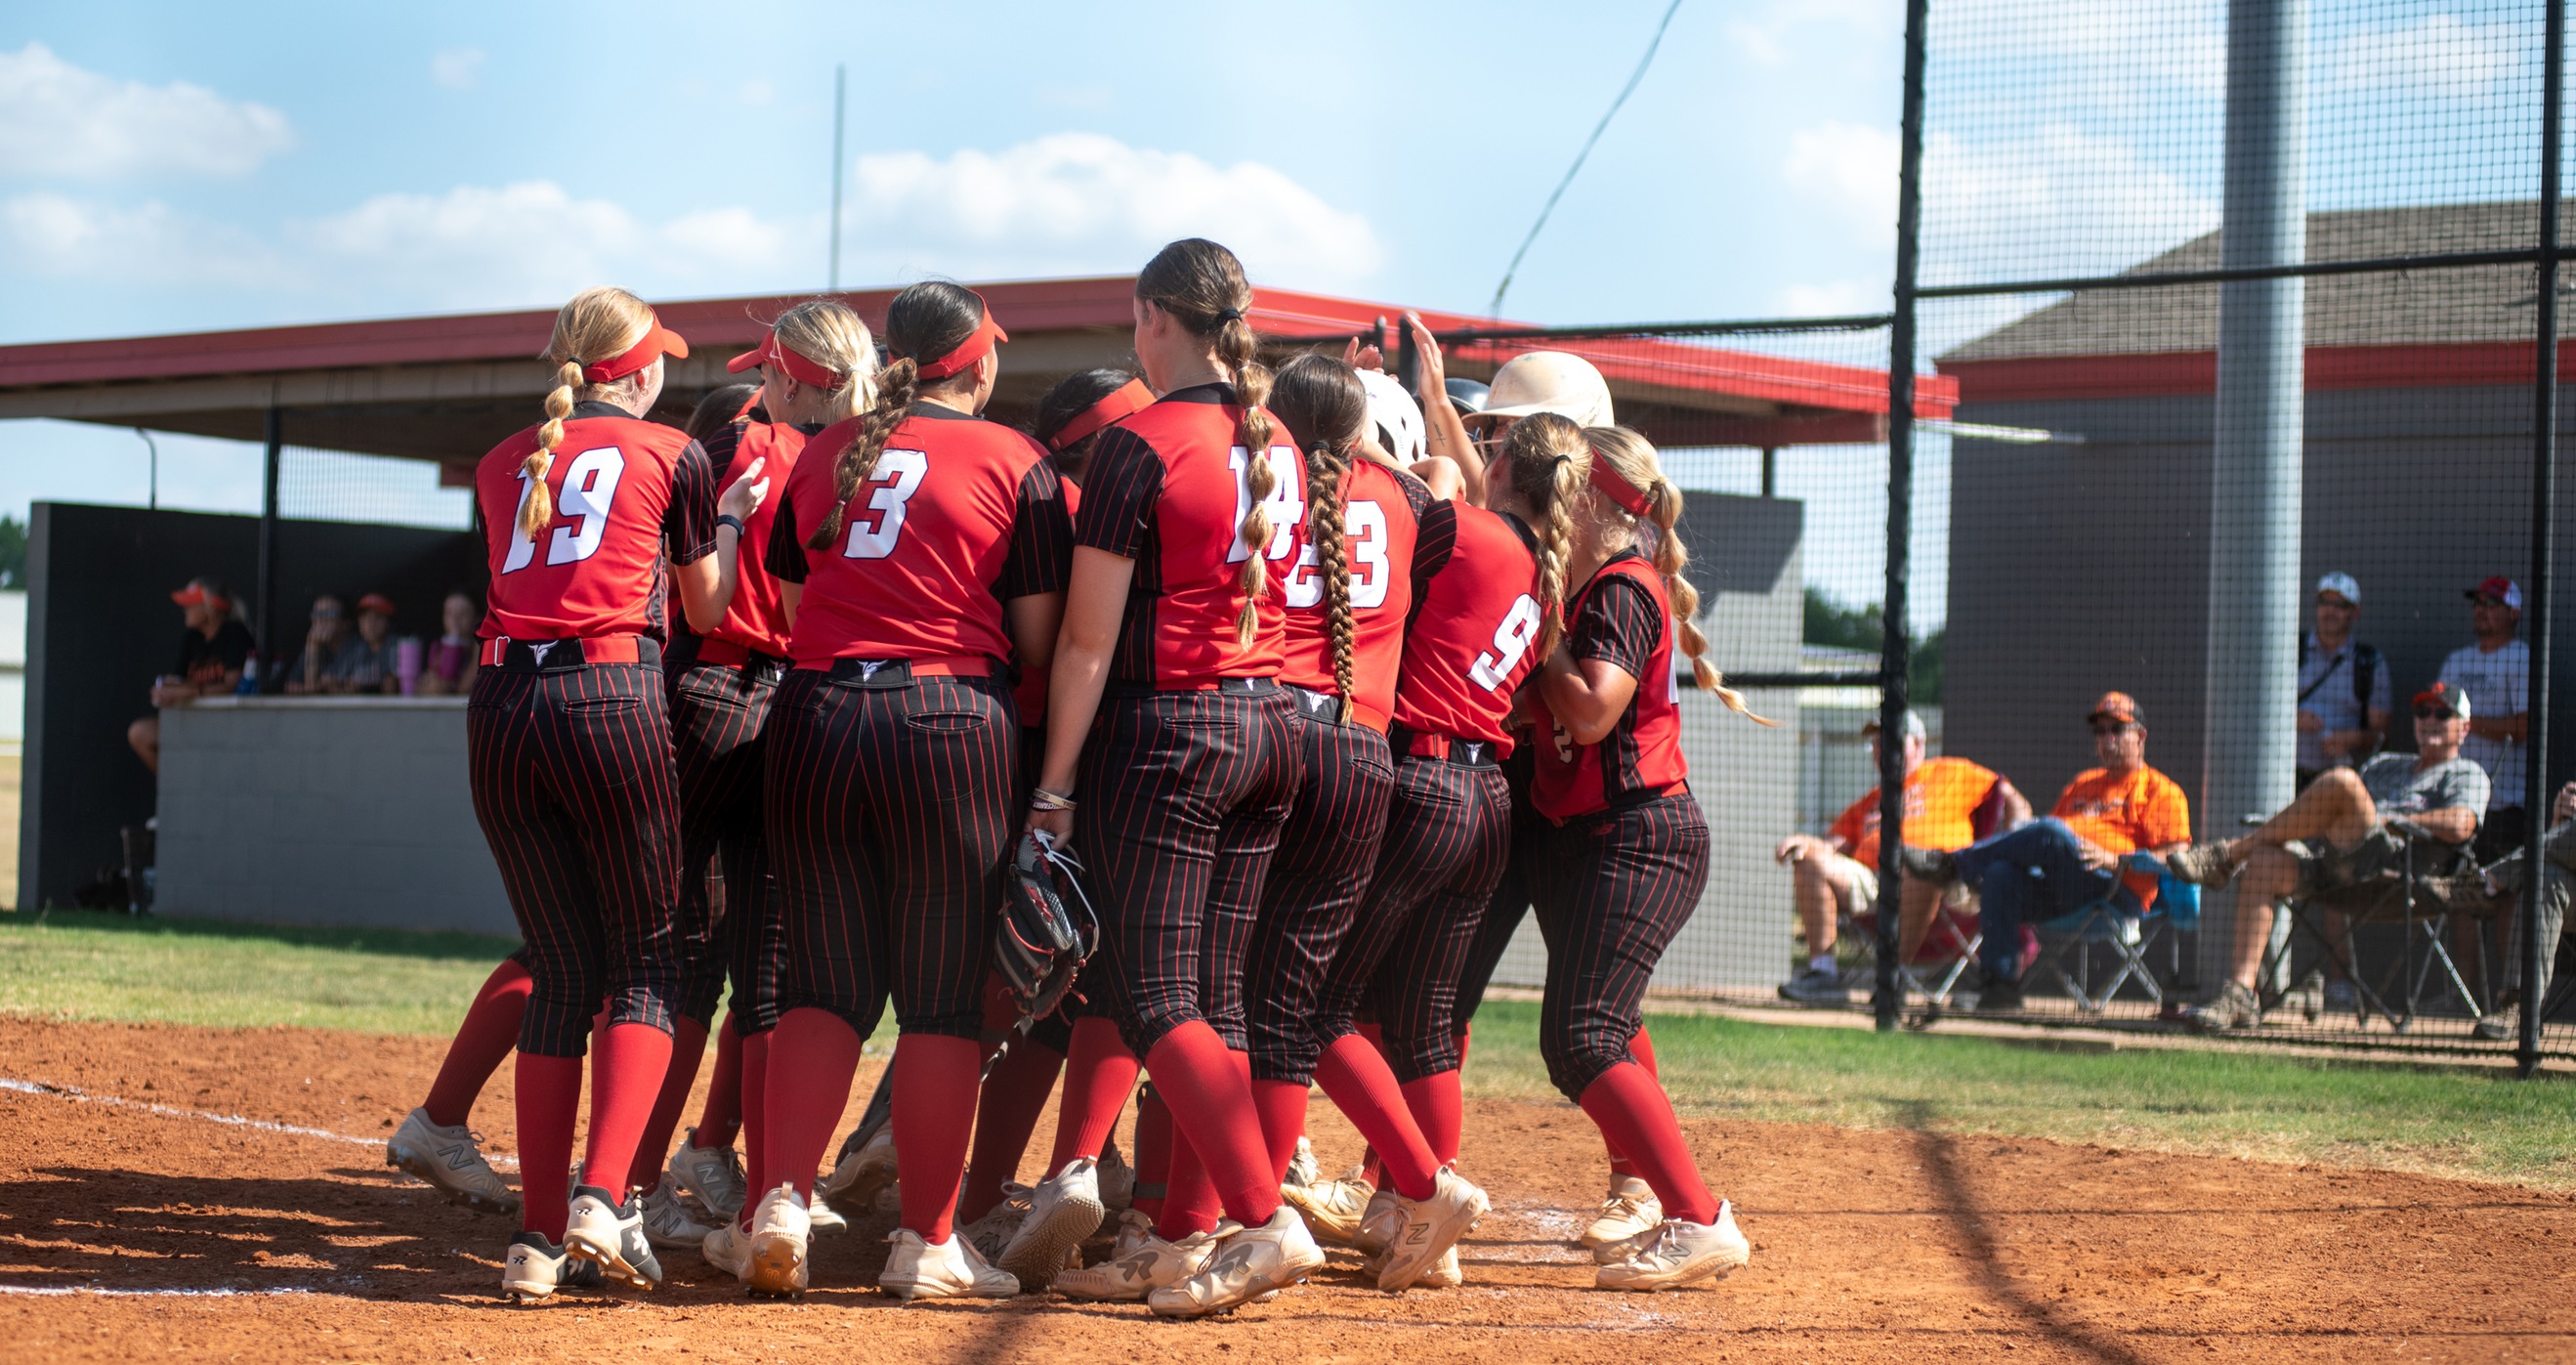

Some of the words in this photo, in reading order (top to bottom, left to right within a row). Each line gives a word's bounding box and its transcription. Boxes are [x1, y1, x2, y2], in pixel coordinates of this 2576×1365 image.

[500, 446, 626, 576] 19
[841, 448, 929, 560] 3
[1225, 445, 1304, 565] 14
[1284, 500, 1390, 609] 23
[1464, 592, 1542, 693] 9
